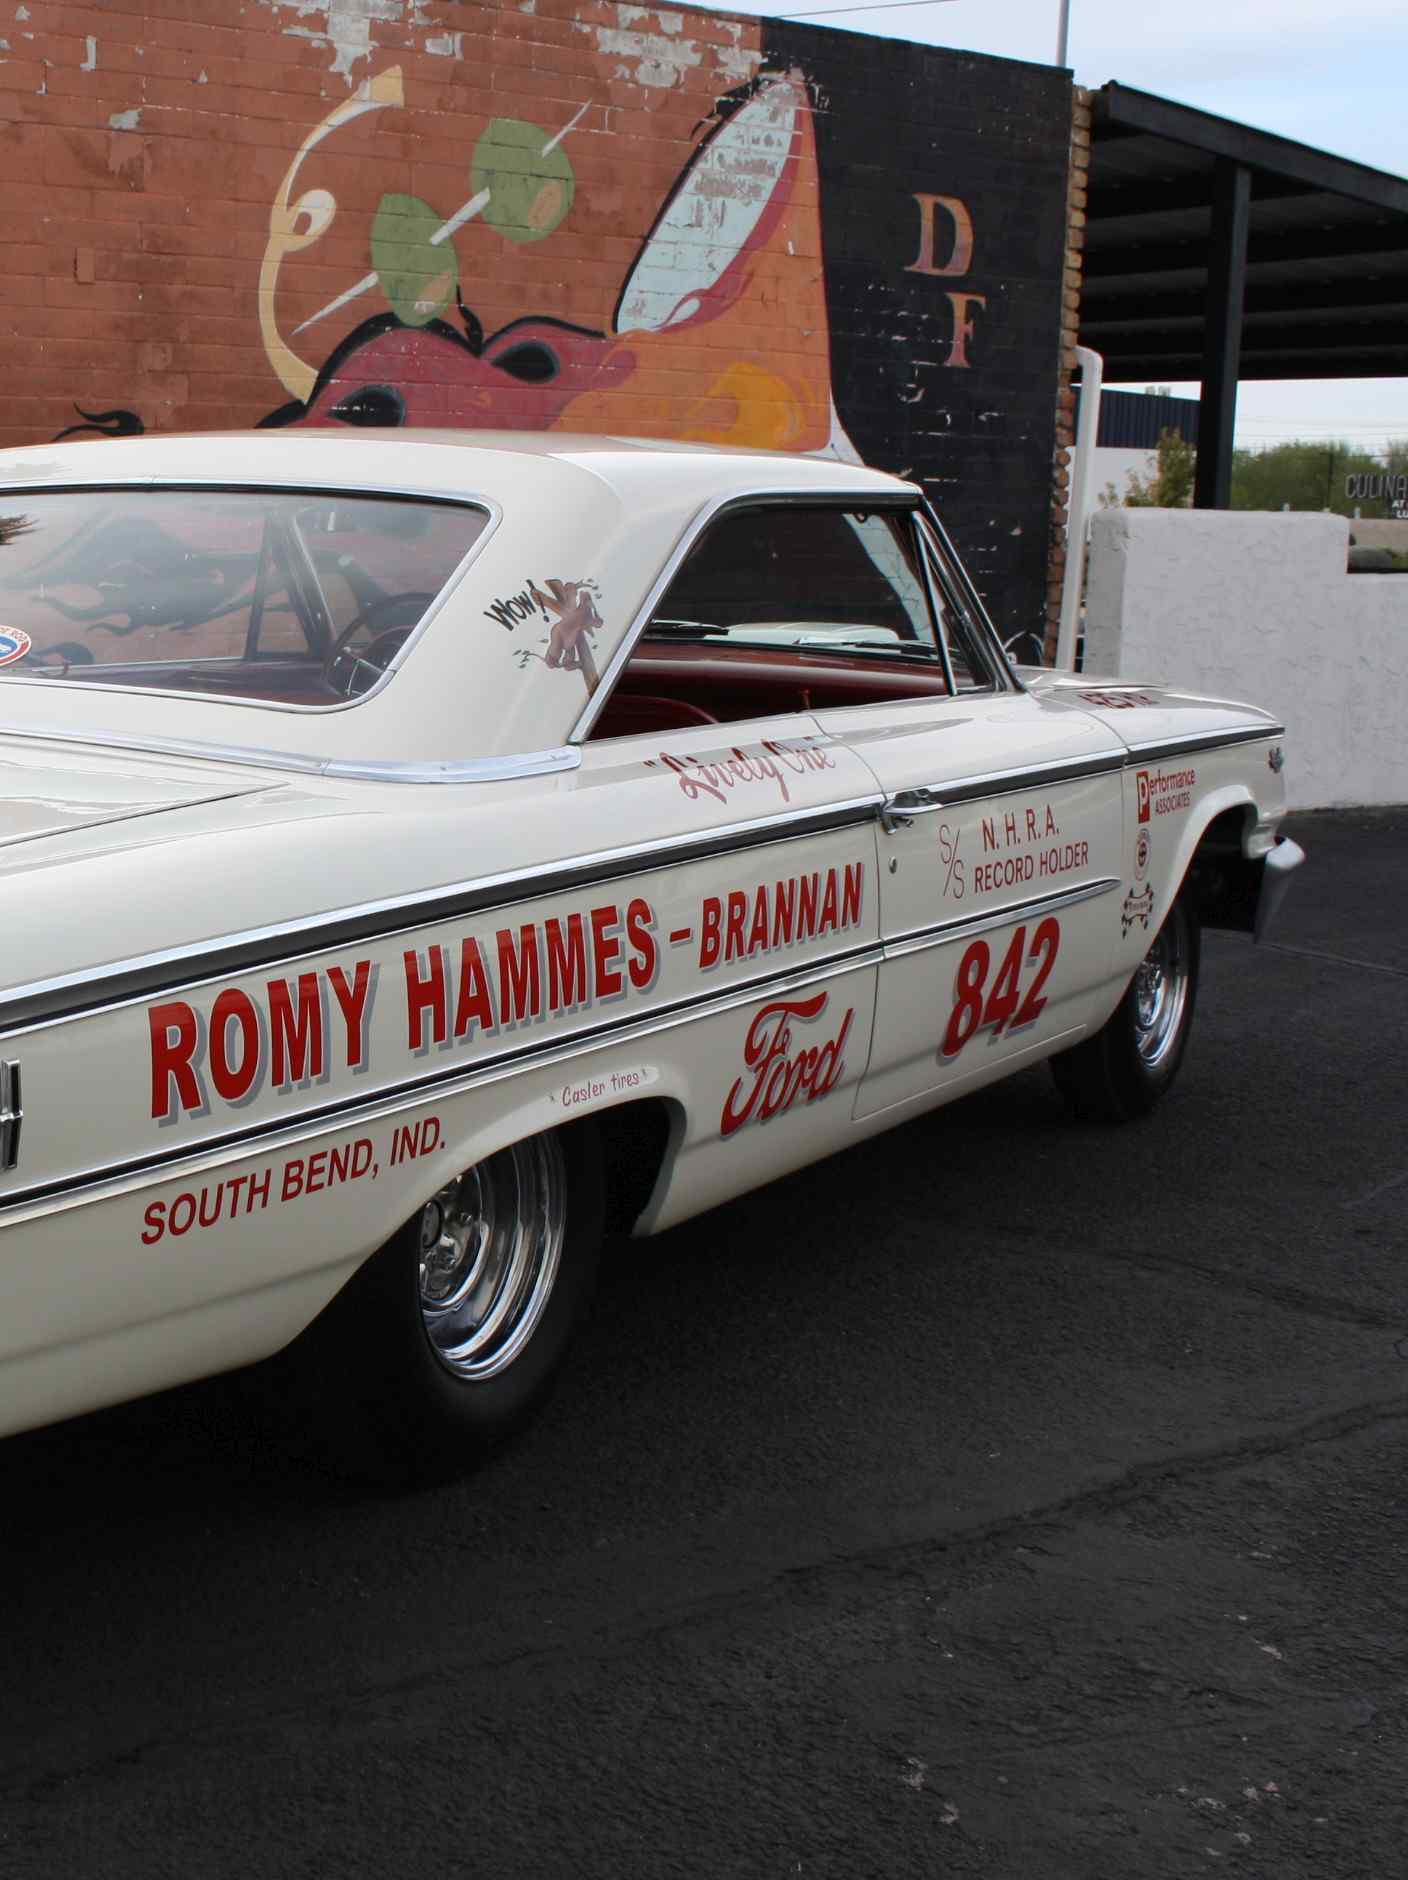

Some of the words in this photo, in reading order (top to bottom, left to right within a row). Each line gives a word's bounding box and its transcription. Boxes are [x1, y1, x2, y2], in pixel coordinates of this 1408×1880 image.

[903, 192, 974, 277] D
[945, 291, 986, 368] F
[975, 855, 1034, 893] RECORD
[1039, 841, 1088, 877] HOLDER
[148, 960, 378, 1126] ROMY
[403, 898, 658, 1055] HAMMES
[699, 862, 863, 969] BRANNAN
[939, 916, 1061, 1062] 842
[720, 991, 854, 1138] Ford
[141, 1168, 272, 1245] SOUTH
[281, 1137, 379, 1202] BEND,
[390, 1116, 446, 1167] IND.
